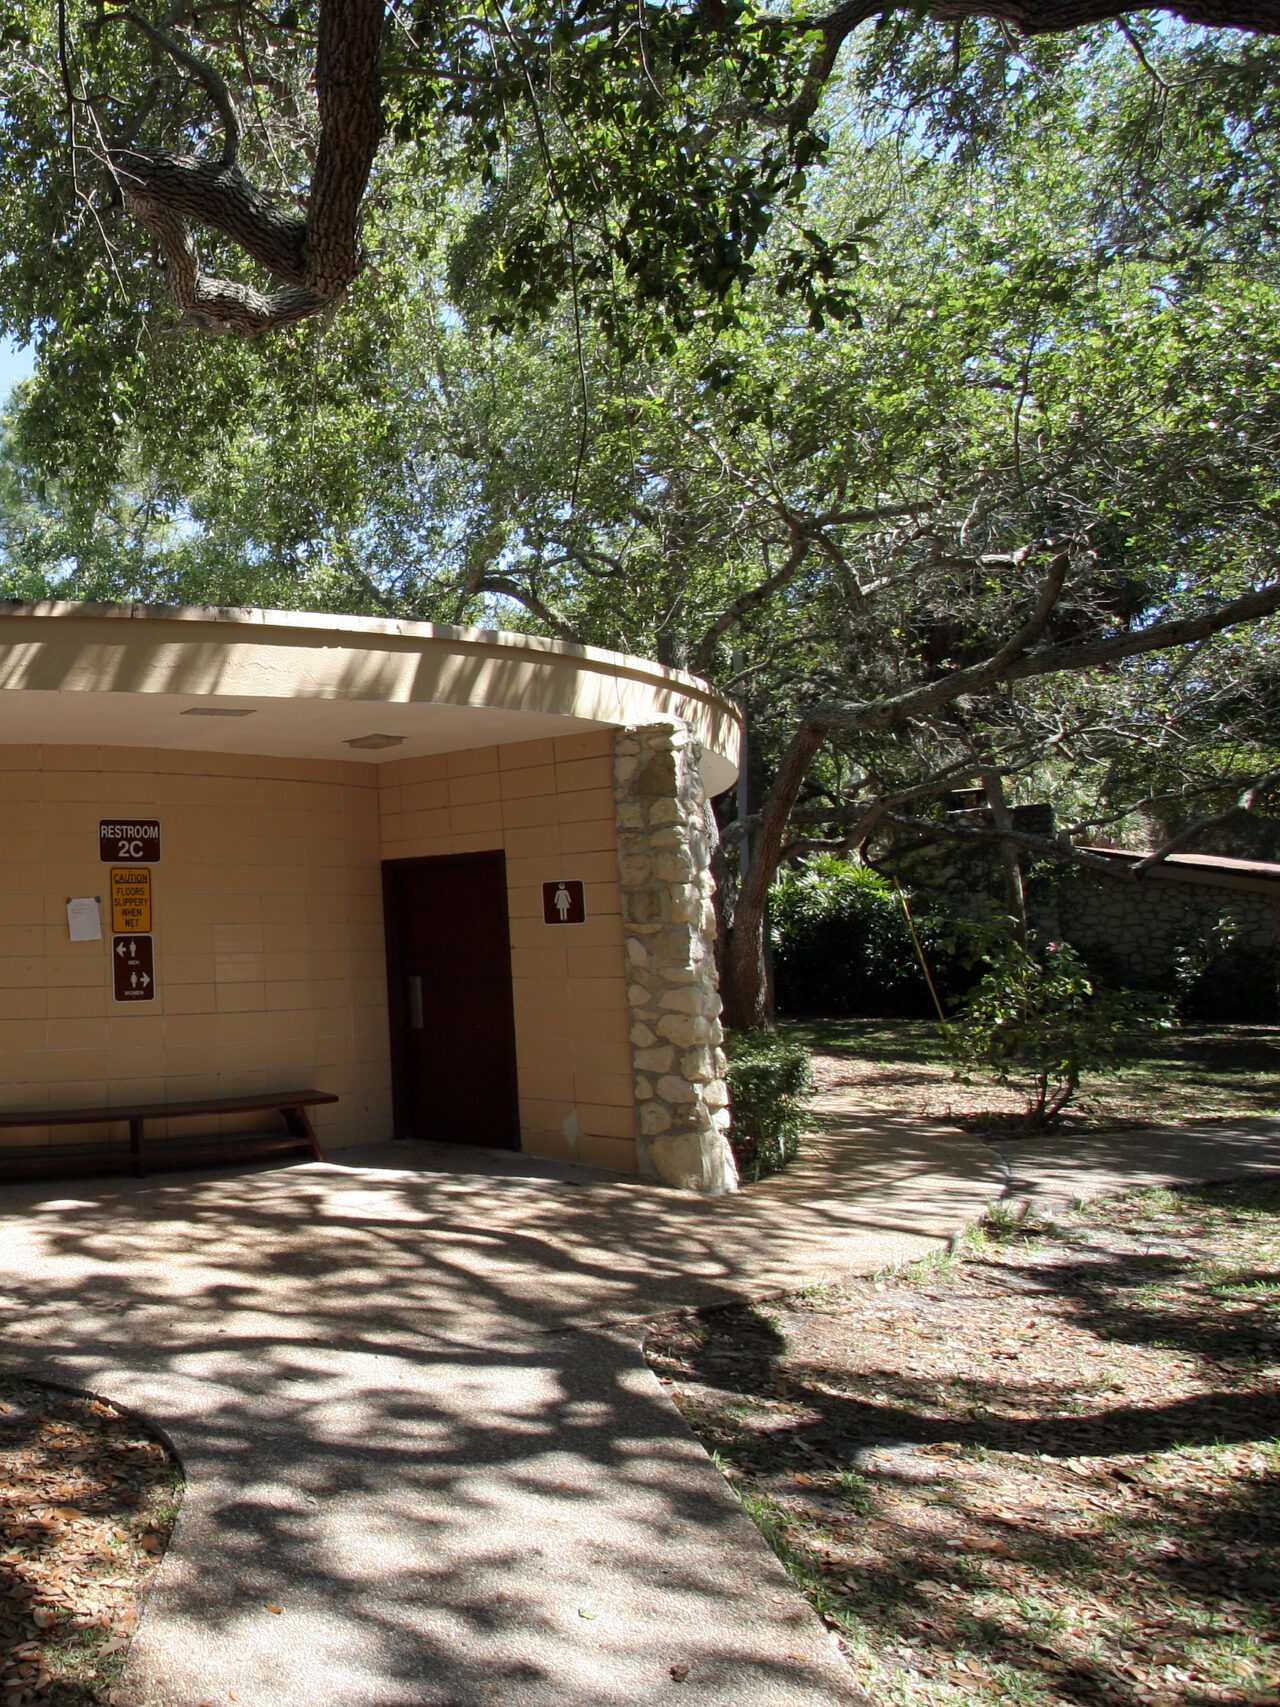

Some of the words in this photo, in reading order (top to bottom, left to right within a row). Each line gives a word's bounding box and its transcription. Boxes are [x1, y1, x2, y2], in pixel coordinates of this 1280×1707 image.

[101, 825, 159, 838] RESTROOM
[118, 840, 144, 858] 2C
[113, 873, 148, 882] CAUTION
[117, 887, 145, 896] FLOORS
[114, 897, 148, 907] SLIPPERY
[122, 908, 142, 917] WHEN
[124, 919, 139, 927] WET
